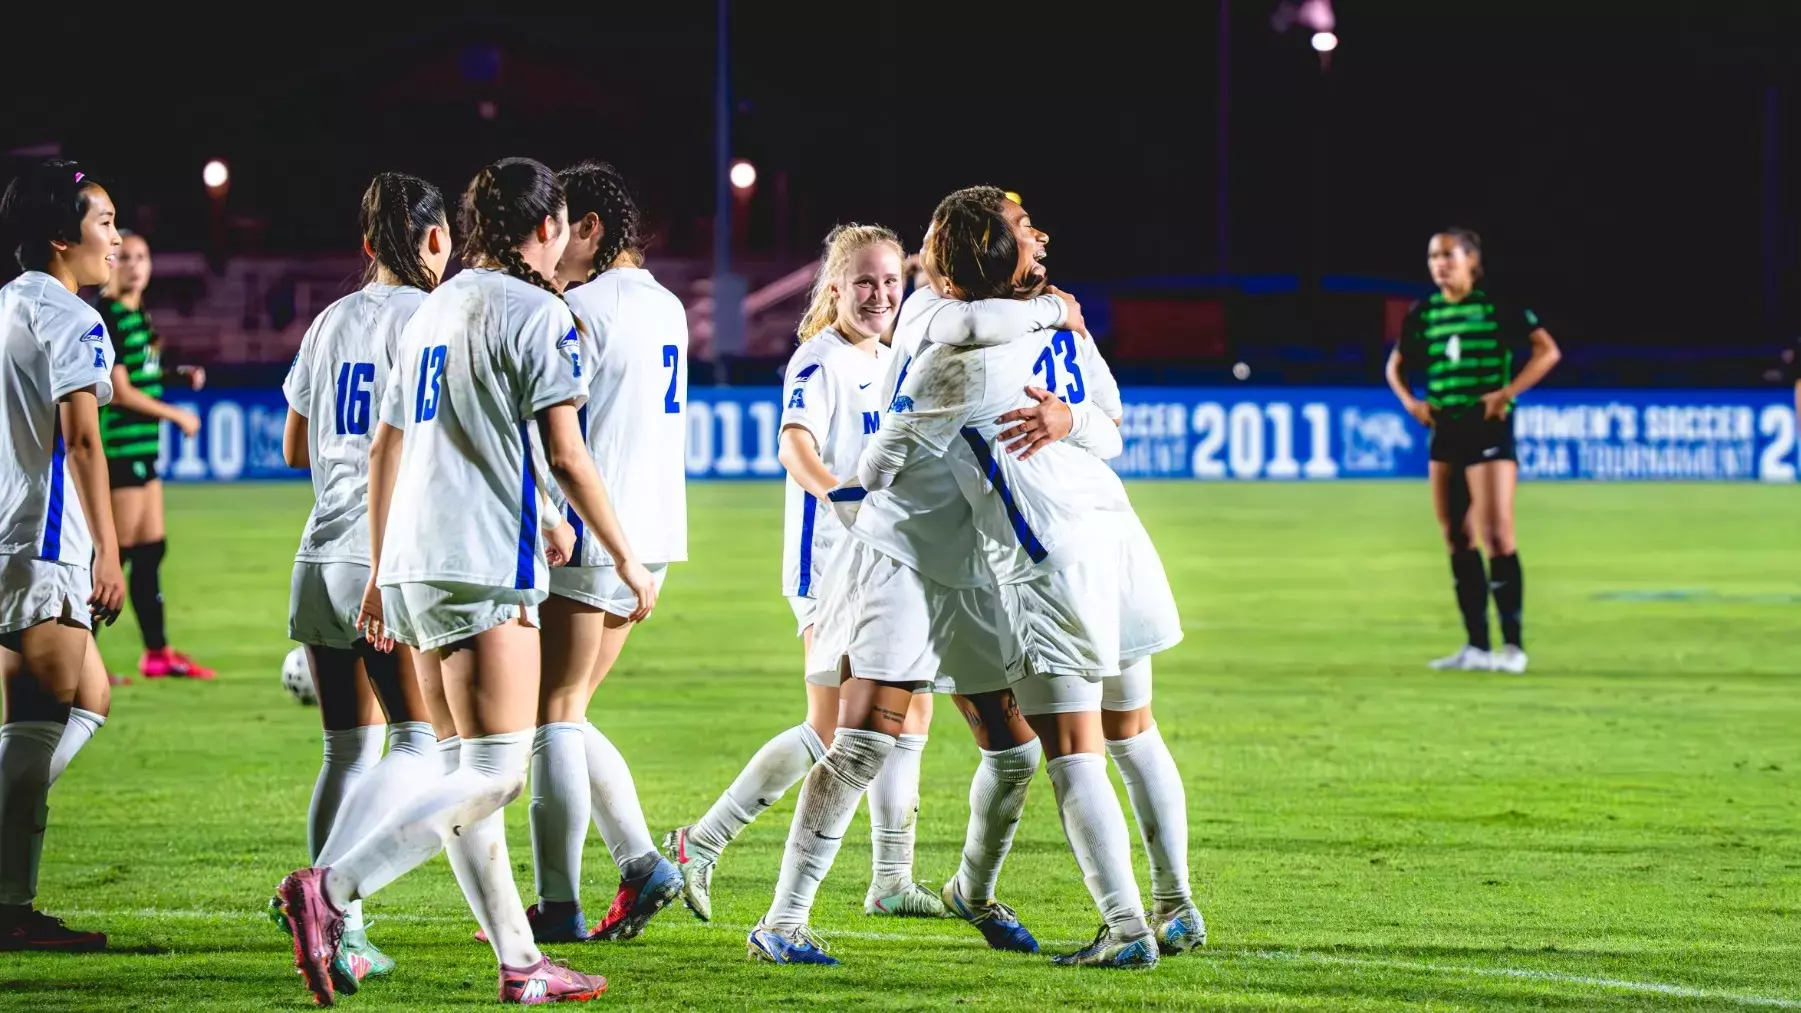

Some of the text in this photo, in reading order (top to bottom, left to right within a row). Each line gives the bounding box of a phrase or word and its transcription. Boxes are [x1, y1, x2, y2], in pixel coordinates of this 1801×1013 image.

[336, 362, 375, 435] 16
[415, 345, 447, 423] 13
[663, 345, 680, 413] 2
[1032, 330, 1085, 404] 23
[686, 401, 782, 475] 011
[1193, 402, 1338, 478] 2011
[1516, 440, 1753, 477] CAA TOURNAMENT
[1645, 405, 1753, 440] SOCCER
